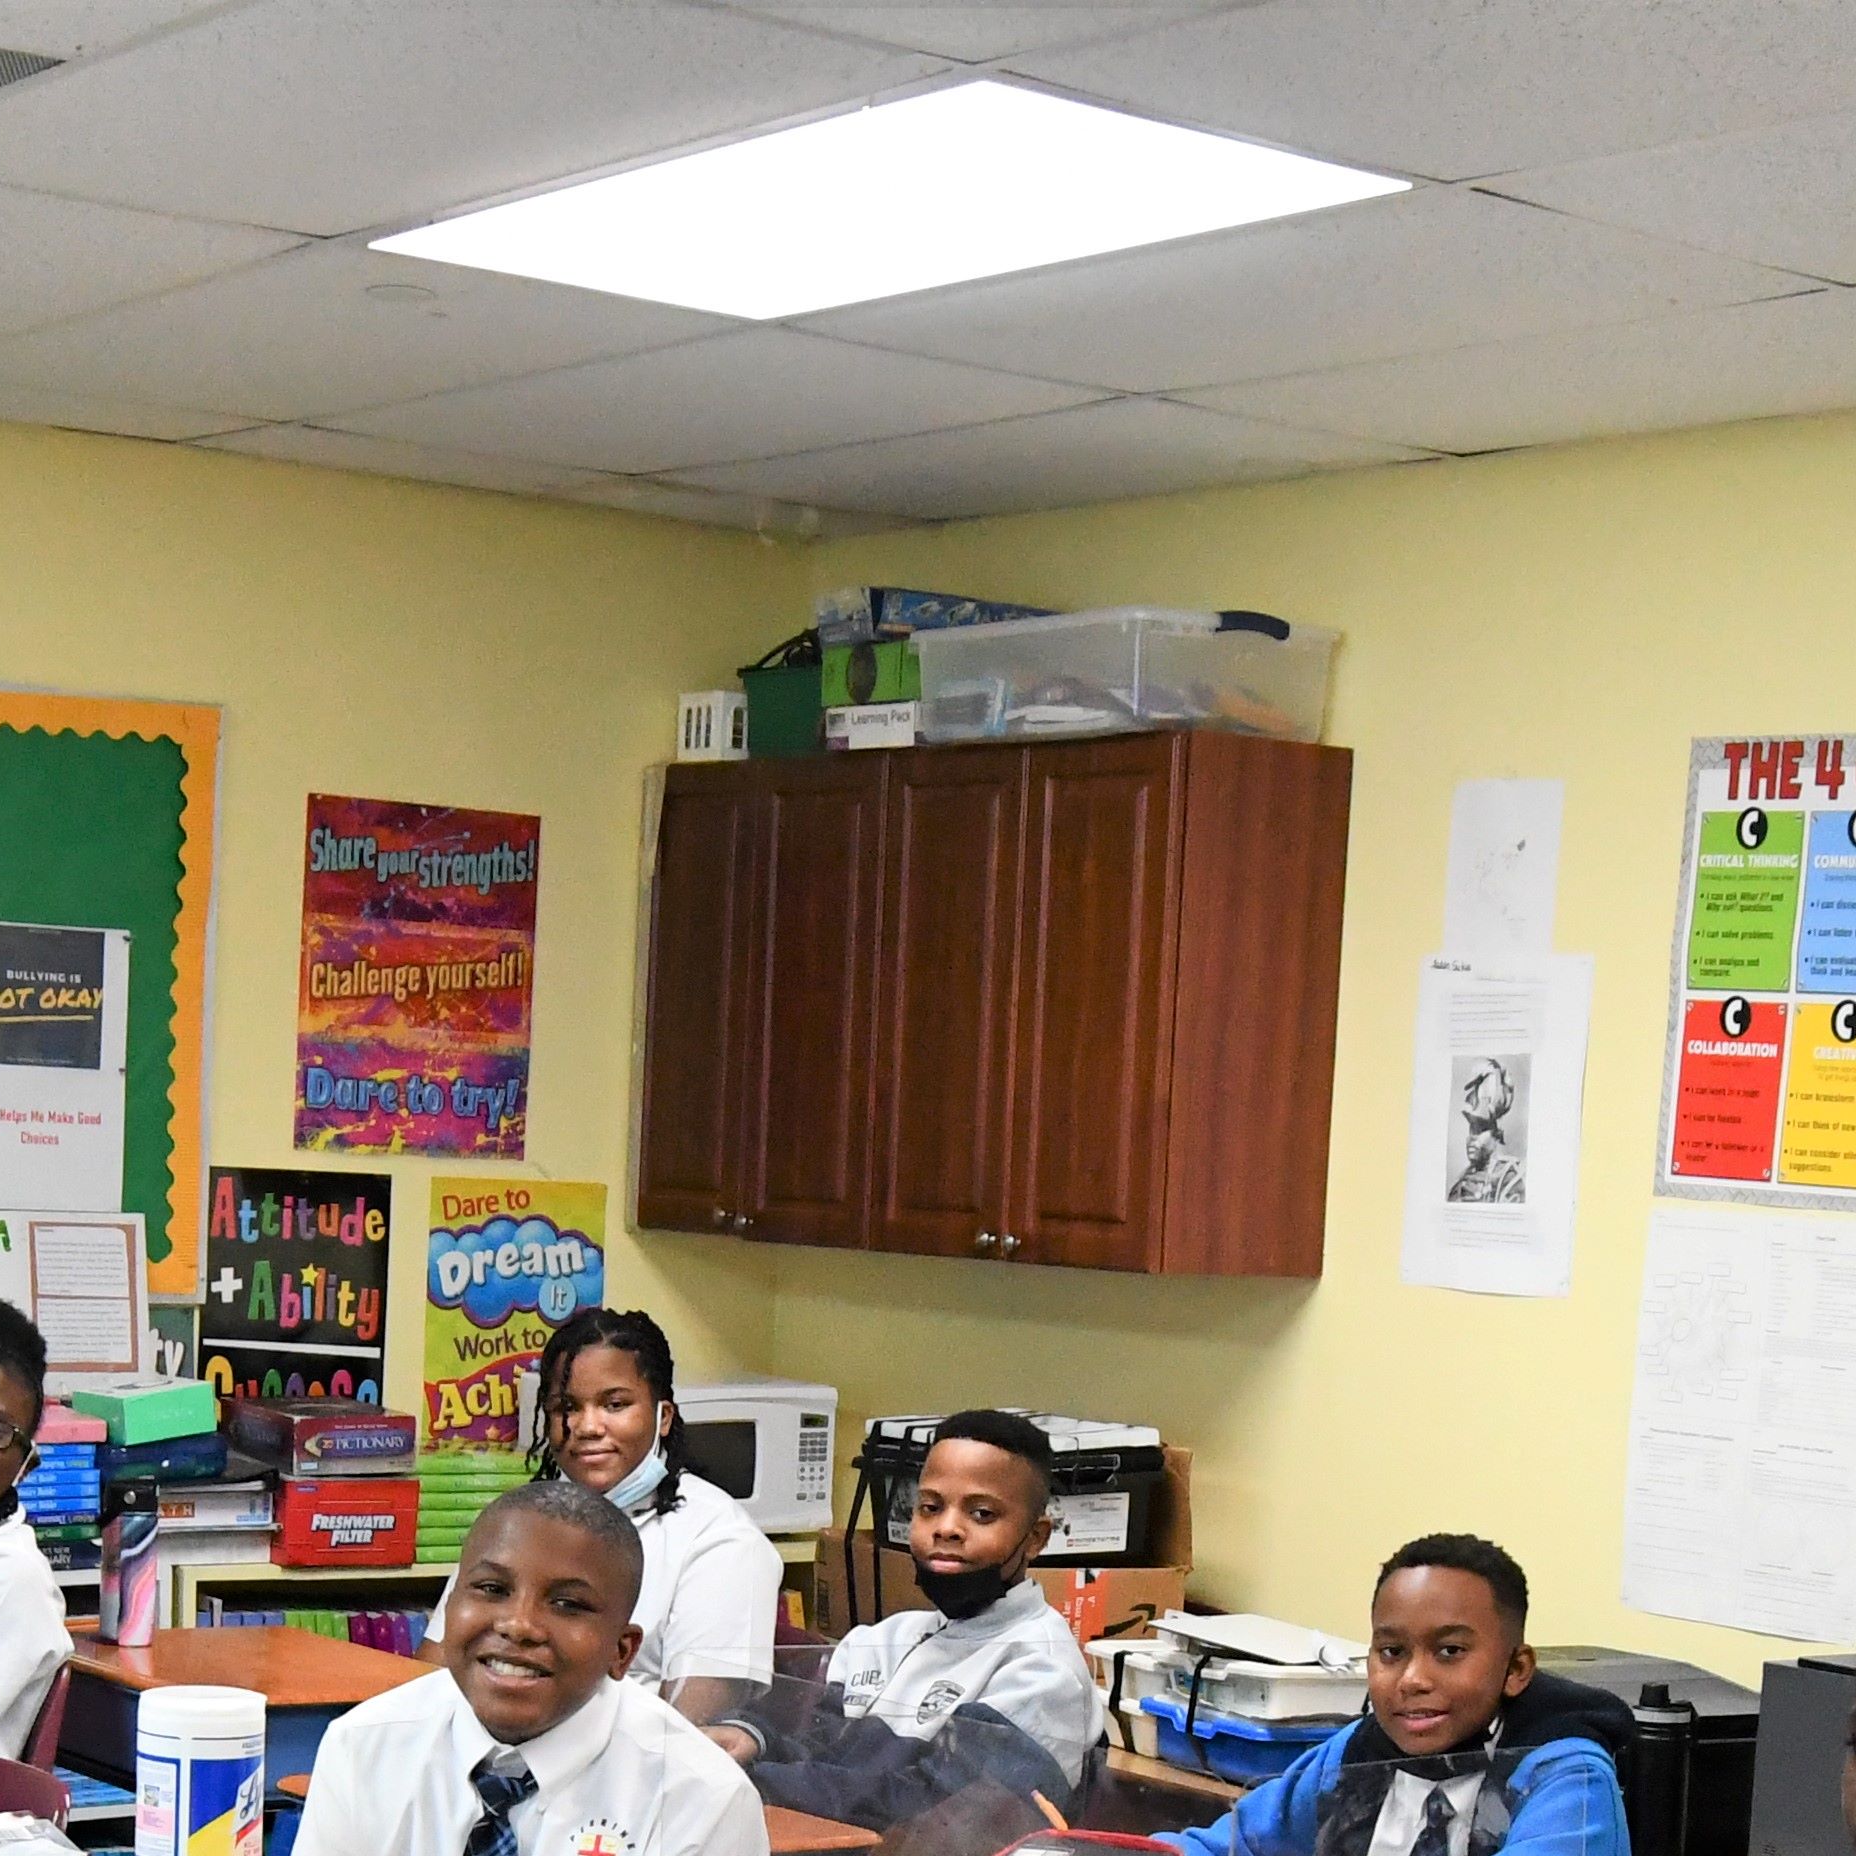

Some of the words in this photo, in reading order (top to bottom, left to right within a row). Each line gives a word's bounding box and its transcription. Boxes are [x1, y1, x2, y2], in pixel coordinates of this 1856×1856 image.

[851, 712, 888, 726] Learning
[890, 710, 910, 722] Pack
[1723, 740, 1804, 801] THE
[1815, 740, 1845, 800] 4
[310, 827, 376, 872] Share
[376, 848, 419, 882] your
[417, 839, 535, 895] strengths!
[1699, 854, 1744, 868] CRITICAL
[1748, 854, 1799, 868] THINKING
[6, 969, 67, 984] BULLYING
[69, 971, 81, 983] IS
[311, 960, 420, 1001] Challenge
[426, 952, 524, 1000] yourself!
[39, 987, 103, 1009] OKAY
[1687, 1040, 1778, 1058] COLLABORATION
[306, 1065, 399, 1113] Dare
[405, 1075, 444, 1115] to
[451, 1076, 521, 1129] try!
[0, 1108, 27, 1125] Helps
[30, 1110, 44, 1123] Me
[48, 1111, 74, 1124] Make
[78, 1111, 101, 1125] Good
[20, 1131, 59, 1145] Choices
[210, 1176, 386, 1247] Attitude
[442, 1193, 502, 1221] Dare
[504, 1188, 531, 1213] to
[437, 1238, 586, 1299] Dream
[248, 1260, 380, 1341] Ability
[550, 1286, 568, 1310] It
[454, 1333, 515, 1362] Work
[522, 1327, 547, 1350] to
[336, 1436, 405, 1450] PICTIONARY
[311, 1513, 396, 1530] FRESHWATER
[330, 1529, 373, 1547] FILTER
